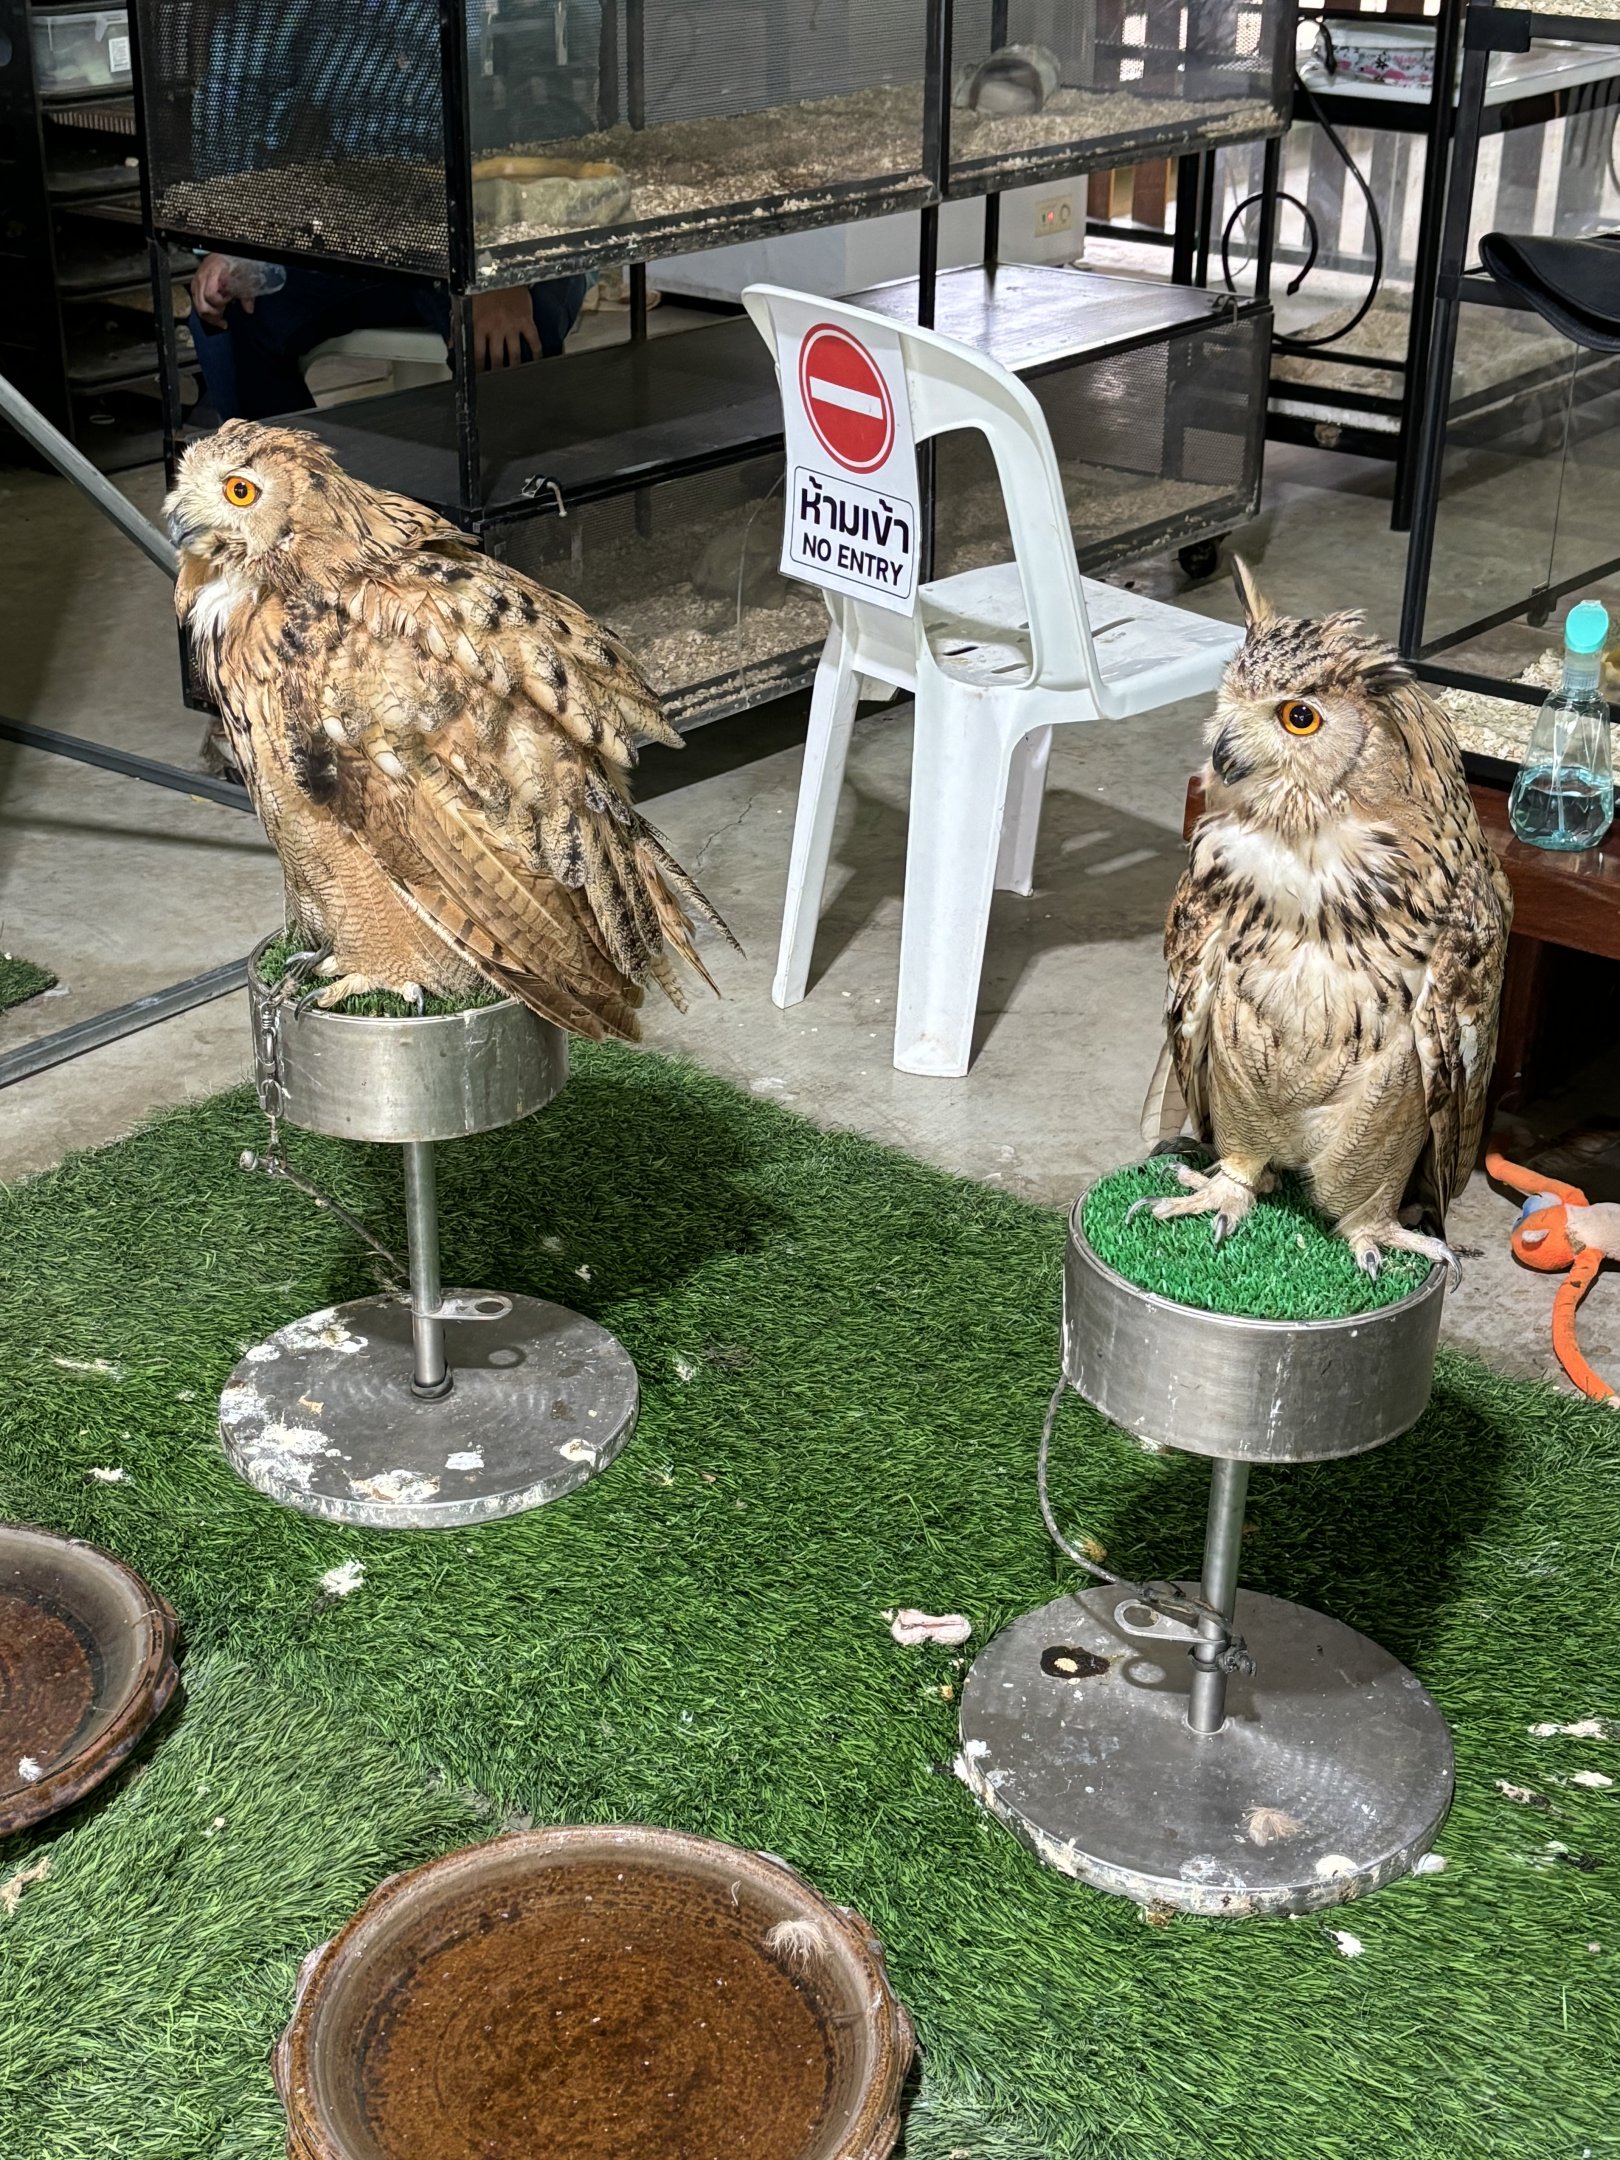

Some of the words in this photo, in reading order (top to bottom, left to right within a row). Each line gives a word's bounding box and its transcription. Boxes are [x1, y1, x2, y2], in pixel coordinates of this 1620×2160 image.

[800, 475, 909, 554] ห้ามเข้า
[802, 532, 832, 562] NO
[837, 543, 904, 586] ENTRY
